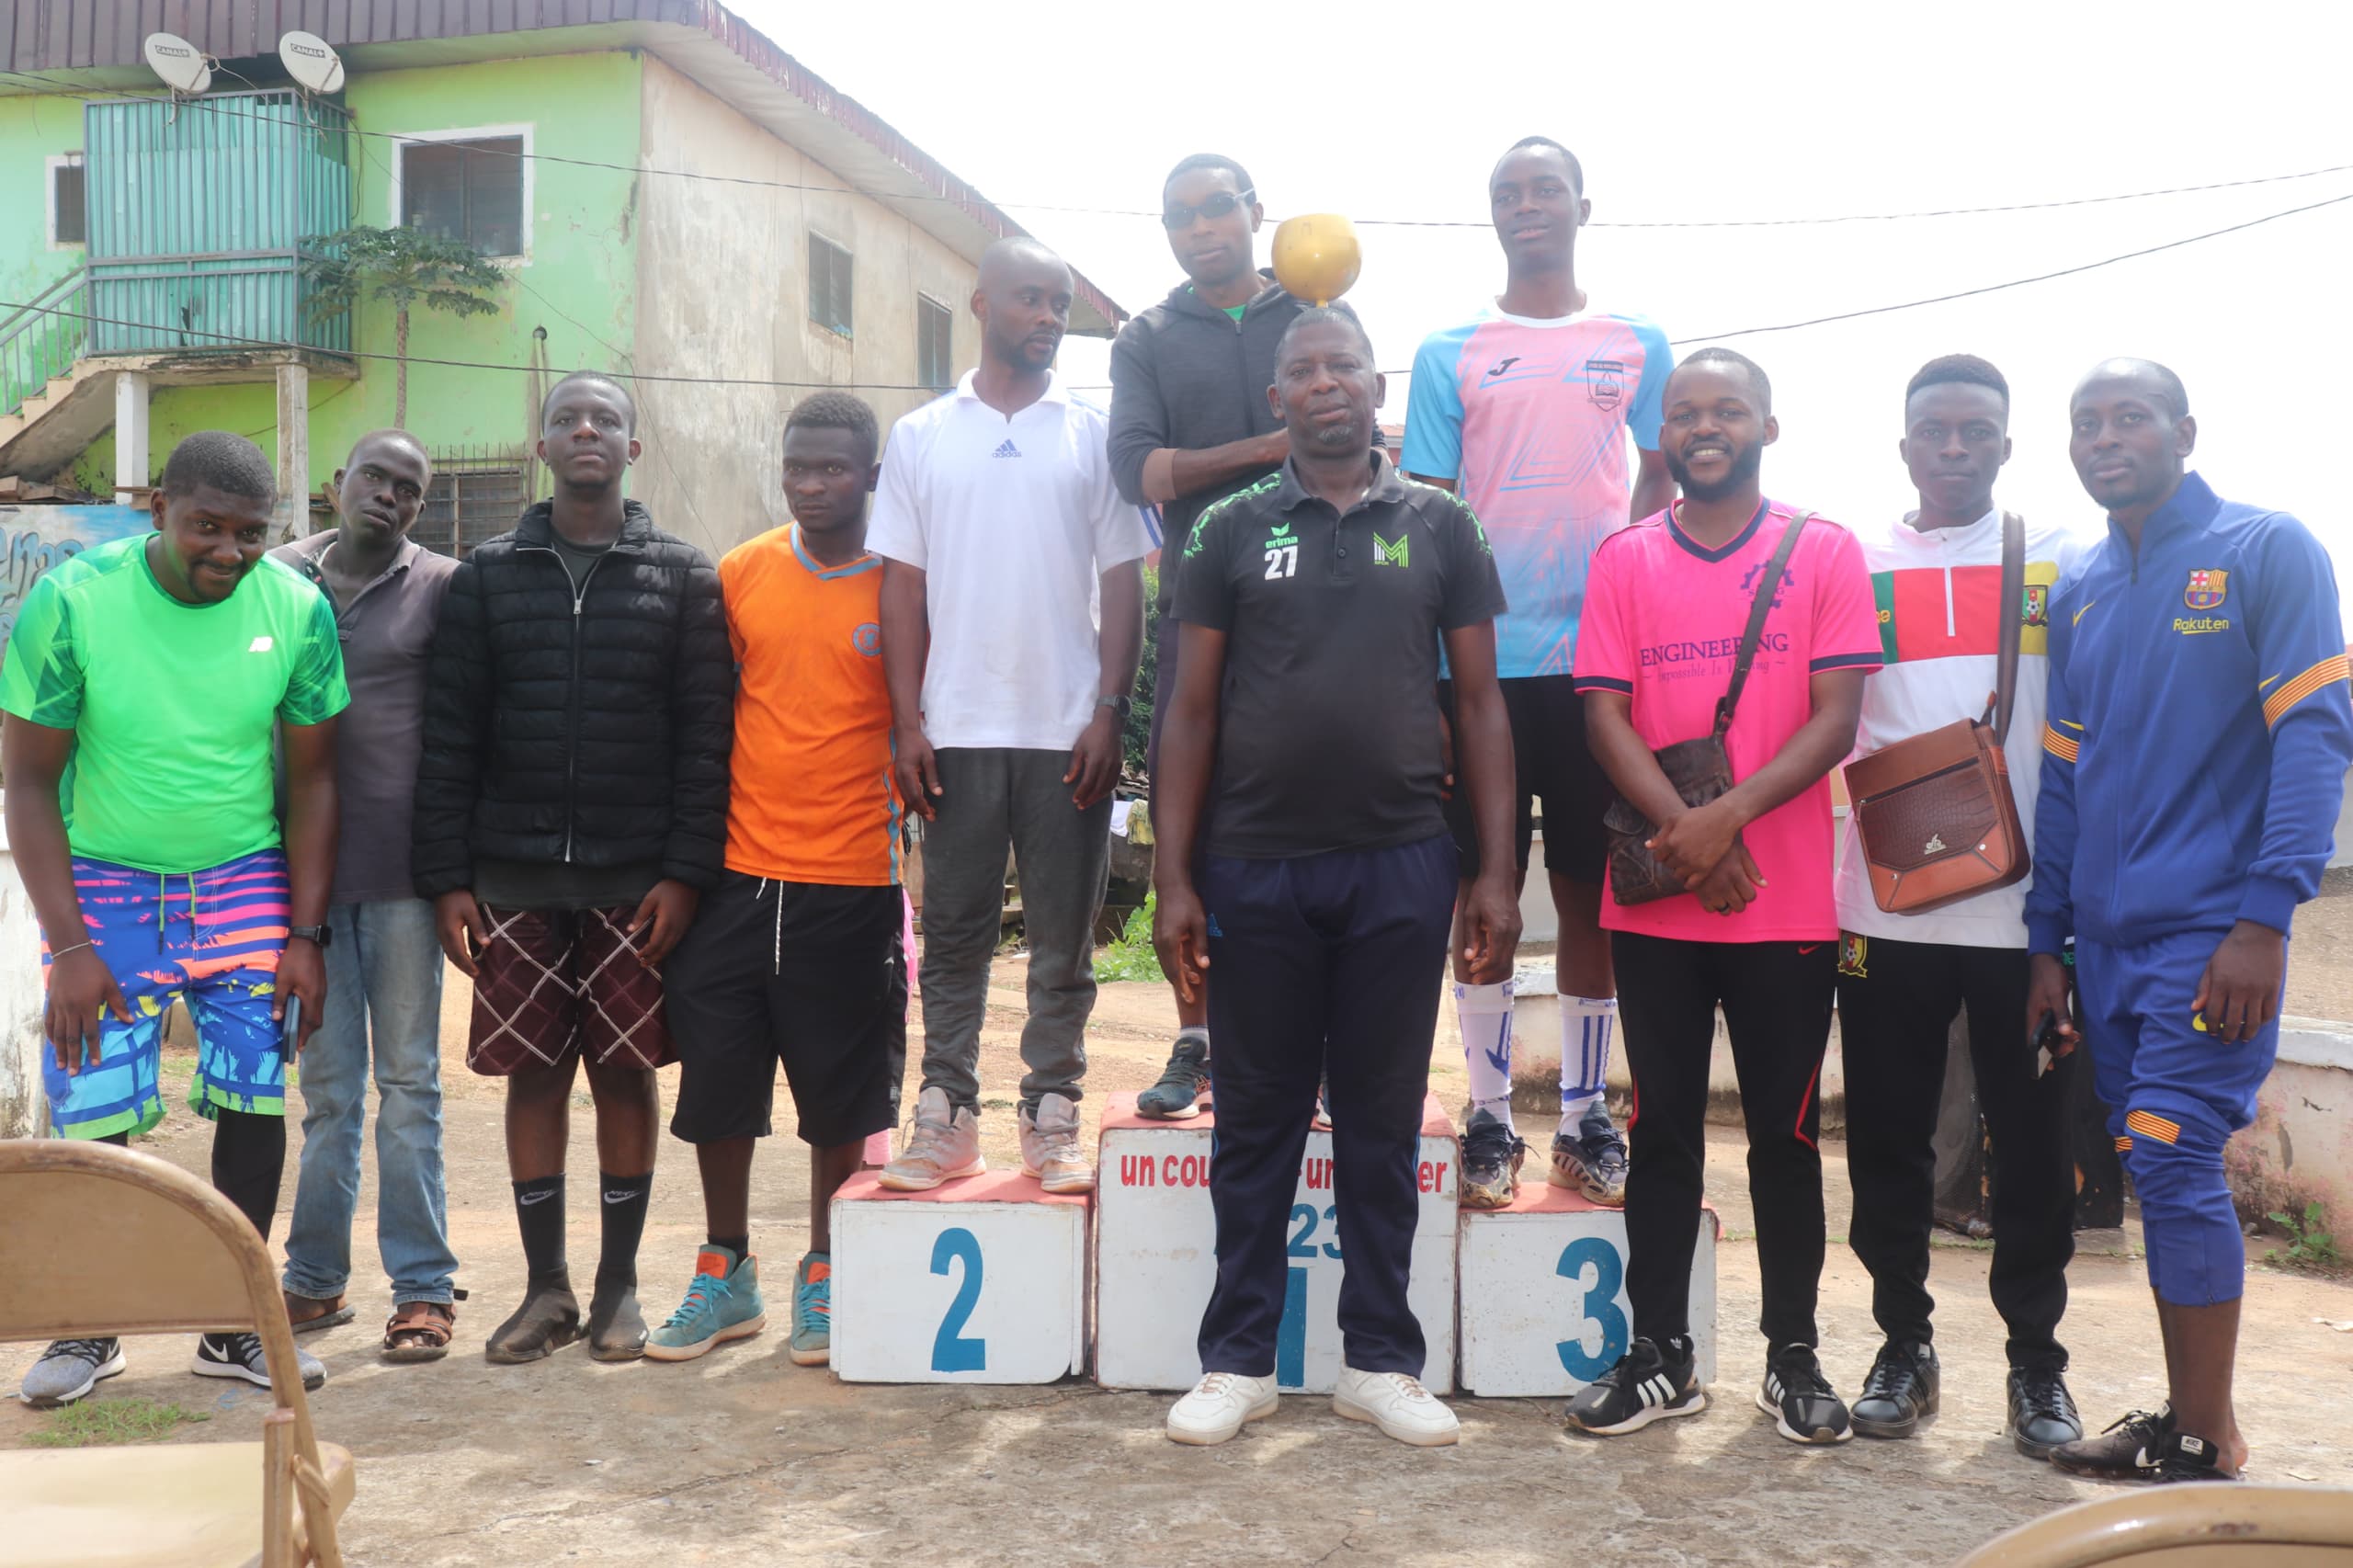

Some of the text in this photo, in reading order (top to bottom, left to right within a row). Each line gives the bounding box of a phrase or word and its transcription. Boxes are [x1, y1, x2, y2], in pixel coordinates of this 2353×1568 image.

[156, 46, 189, 58] CANAL+
[291, 44, 324, 58] CANAL+
[992, 450, 1022, 459] adidas
[1265, 536, 1299, 549] erima
[1264, 545, 1298, 581] 27
[2173, 617, 2229, 632] Rakuten
[1640, 632, 1789, 666] ENGINEERNG
[1120, 1154, 1155, 1187] un
[929, 1227, 986, 1372] 2
[1555, 1236, 1629, 1383] 3
